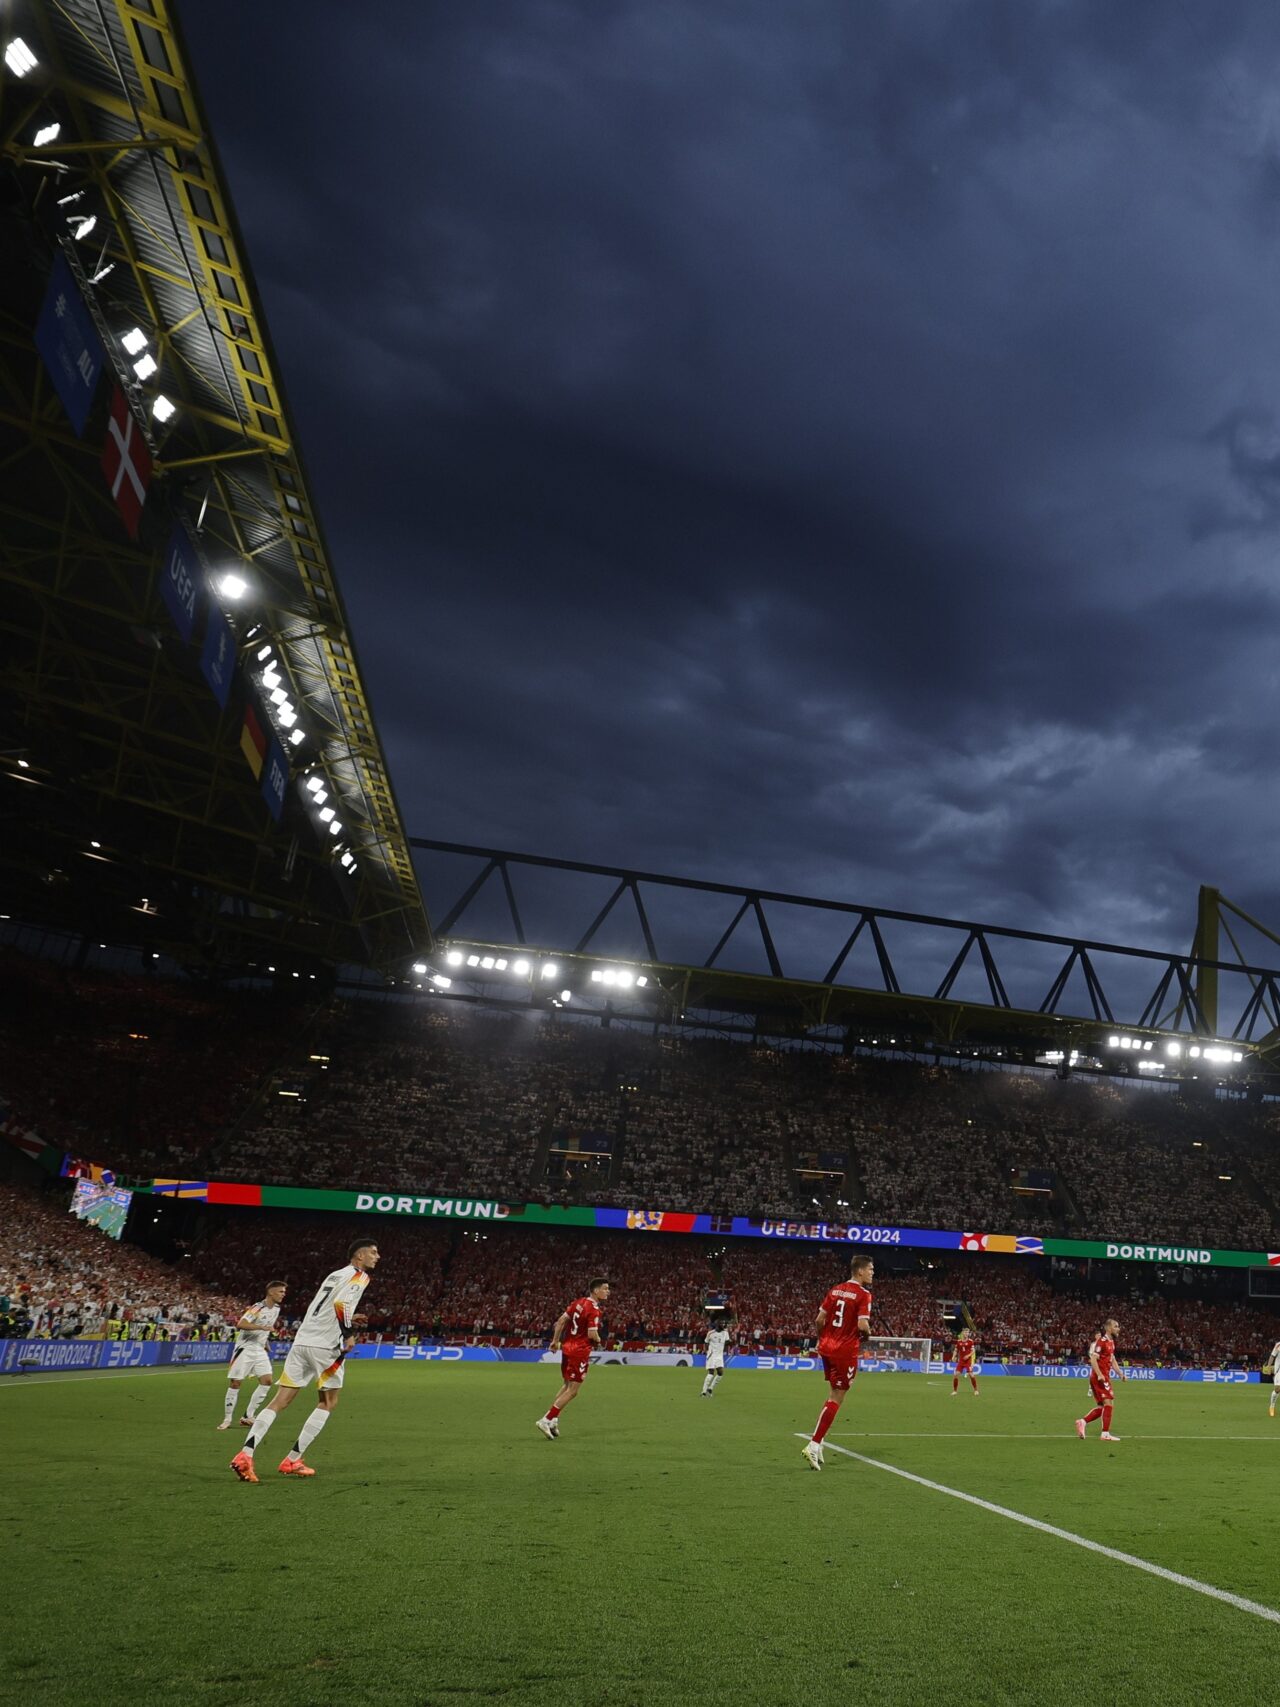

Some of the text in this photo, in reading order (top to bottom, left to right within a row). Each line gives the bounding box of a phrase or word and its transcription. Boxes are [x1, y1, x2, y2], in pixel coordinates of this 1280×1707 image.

[170, 549, 195, 619] UEFA
[269, 757, 285, 801] FIFA
[355, 1194, 510, 1219] DORTMUND
[761, 1220, 901, 1244] UEFAEUO2024
[1106, 1244, 1212, 1264] DORTMUND
[312, 1286, 334, 1317] 7
[570, 1311, 580, 1336] 5
[832, 1300, 845, 1328] 3
[392, 1345, 464, 1361] BYD
[756, 1356, 816, 1371] BYD
[860, 1359, 898, 1372] YD
[1034, 1365, 1069, 1377] BUILD
[1202, 1370, 1249, 1383] BYD
